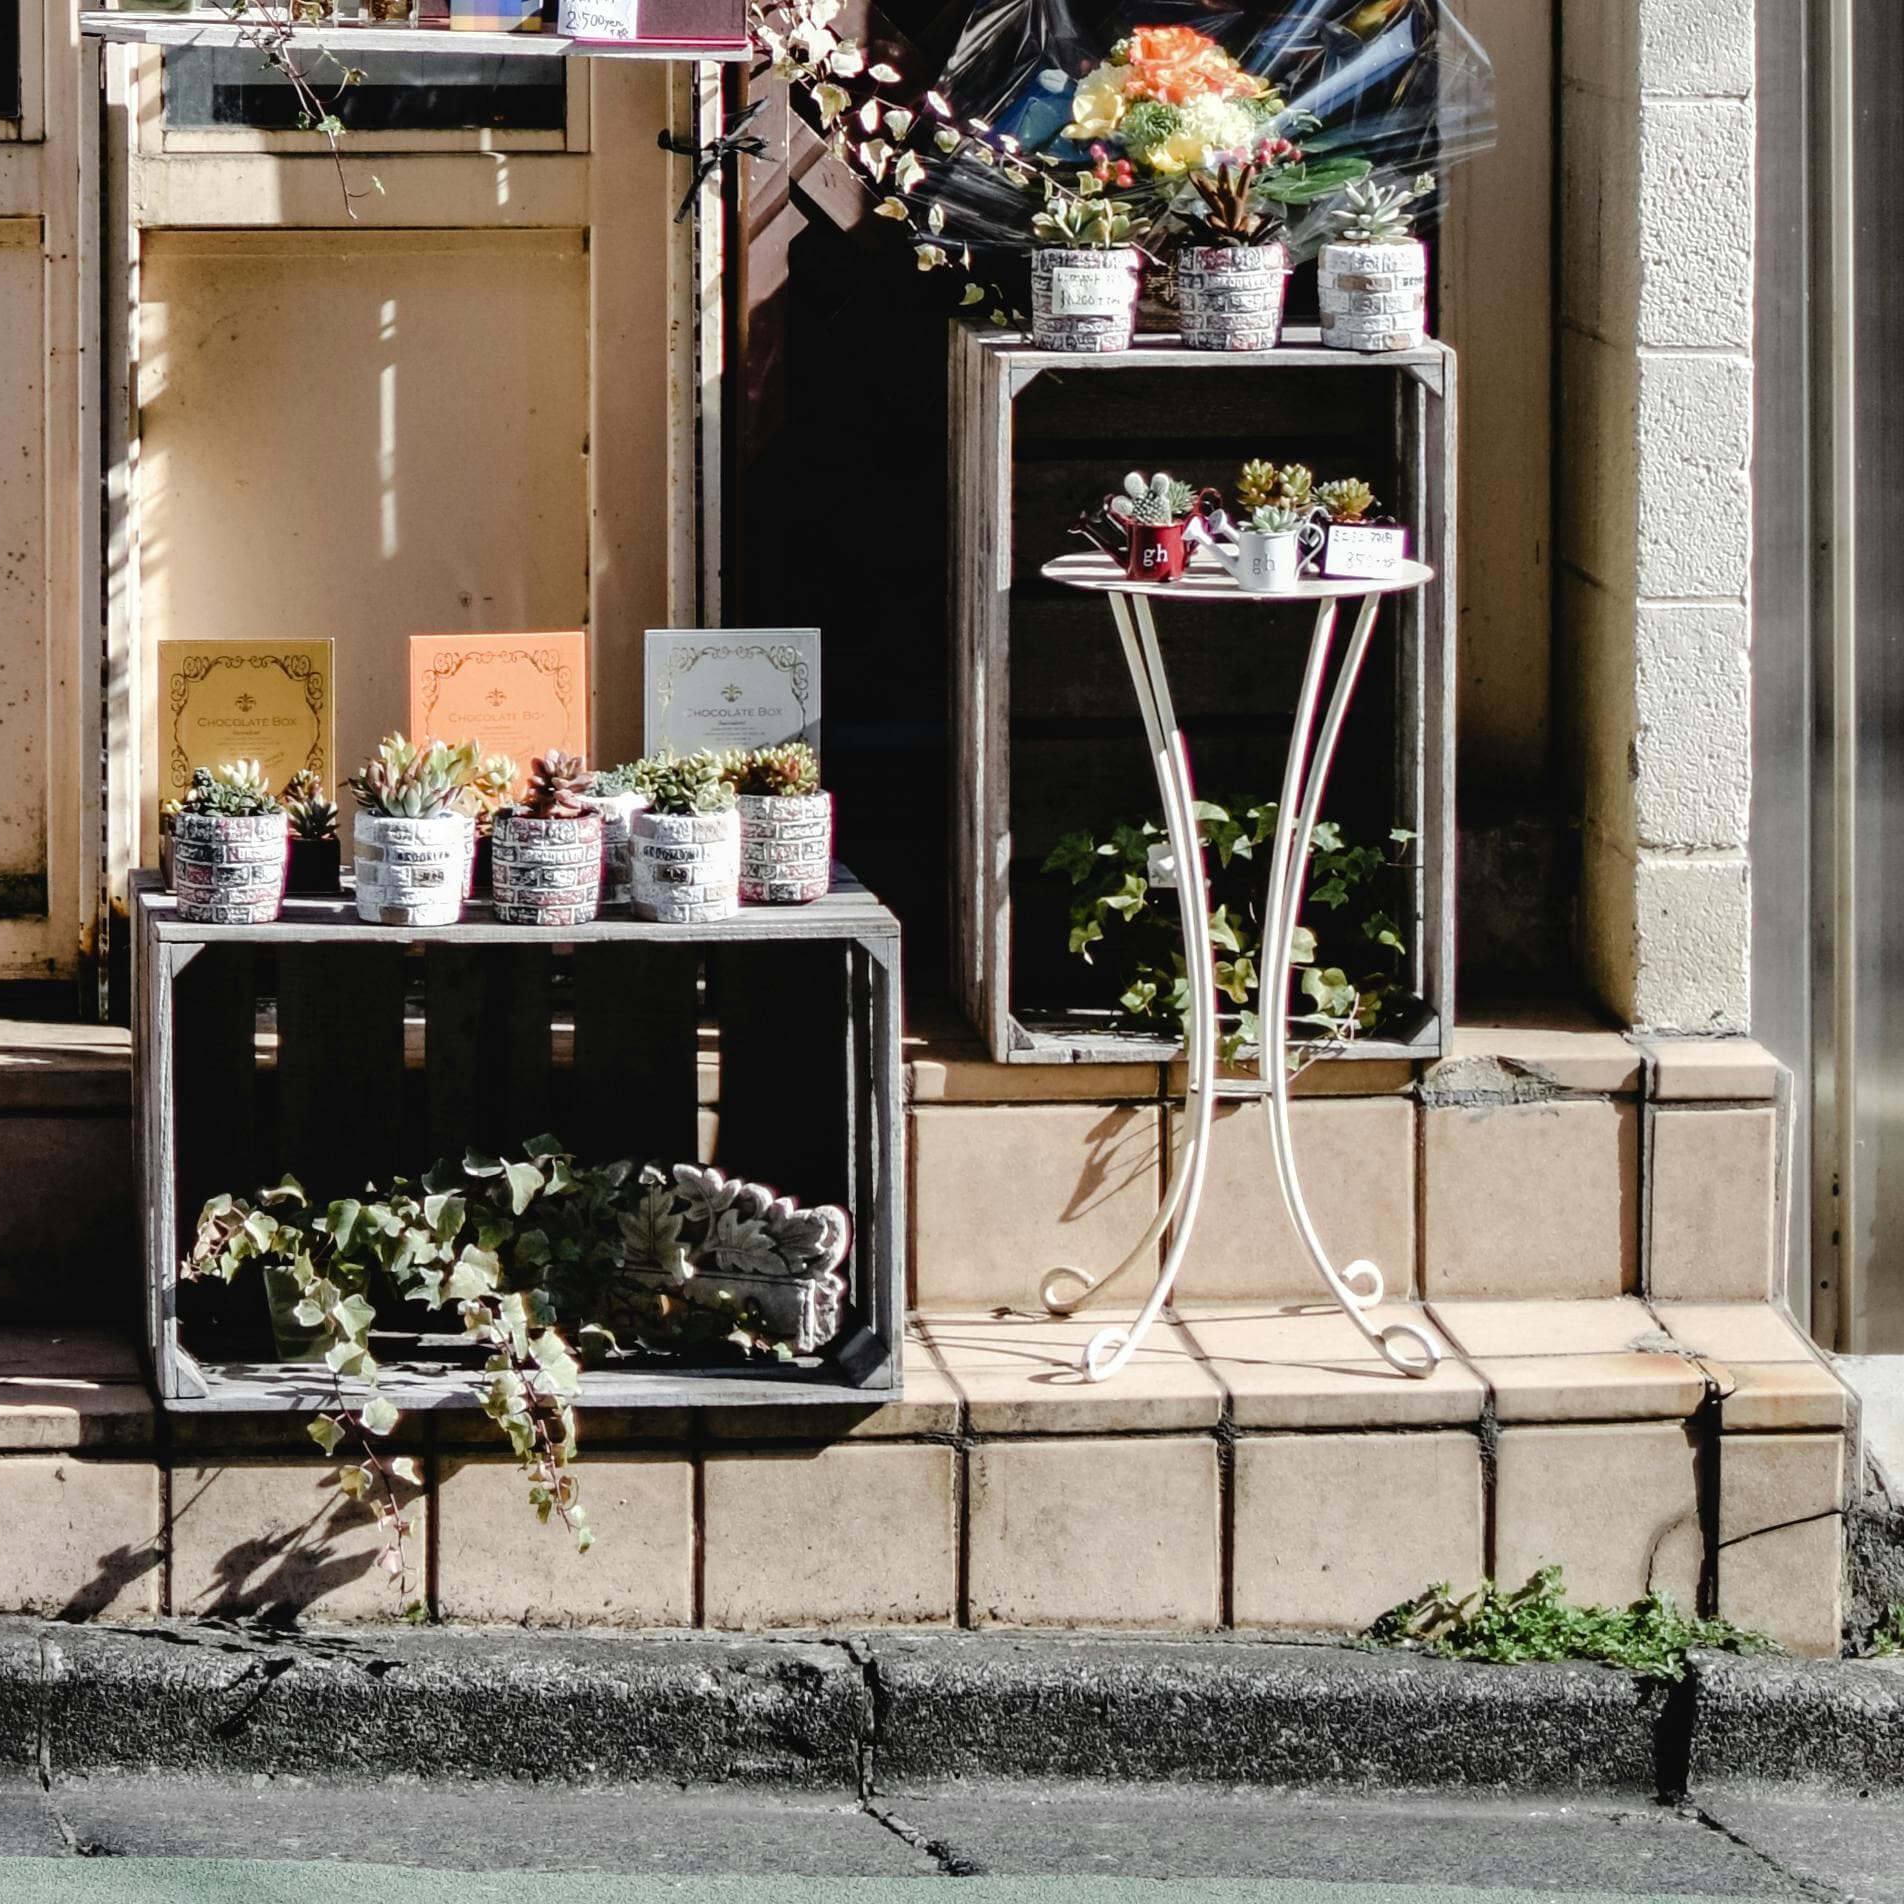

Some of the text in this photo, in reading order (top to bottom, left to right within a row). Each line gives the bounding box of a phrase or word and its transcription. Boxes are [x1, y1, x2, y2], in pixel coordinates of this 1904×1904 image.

[1143, 543, 1169, 567] gh
[1252, 553, 1276, 575] gh
[757, 706, 783, 718] BOX
[197, 716, 297, 728] CHOCOLATE BOX
